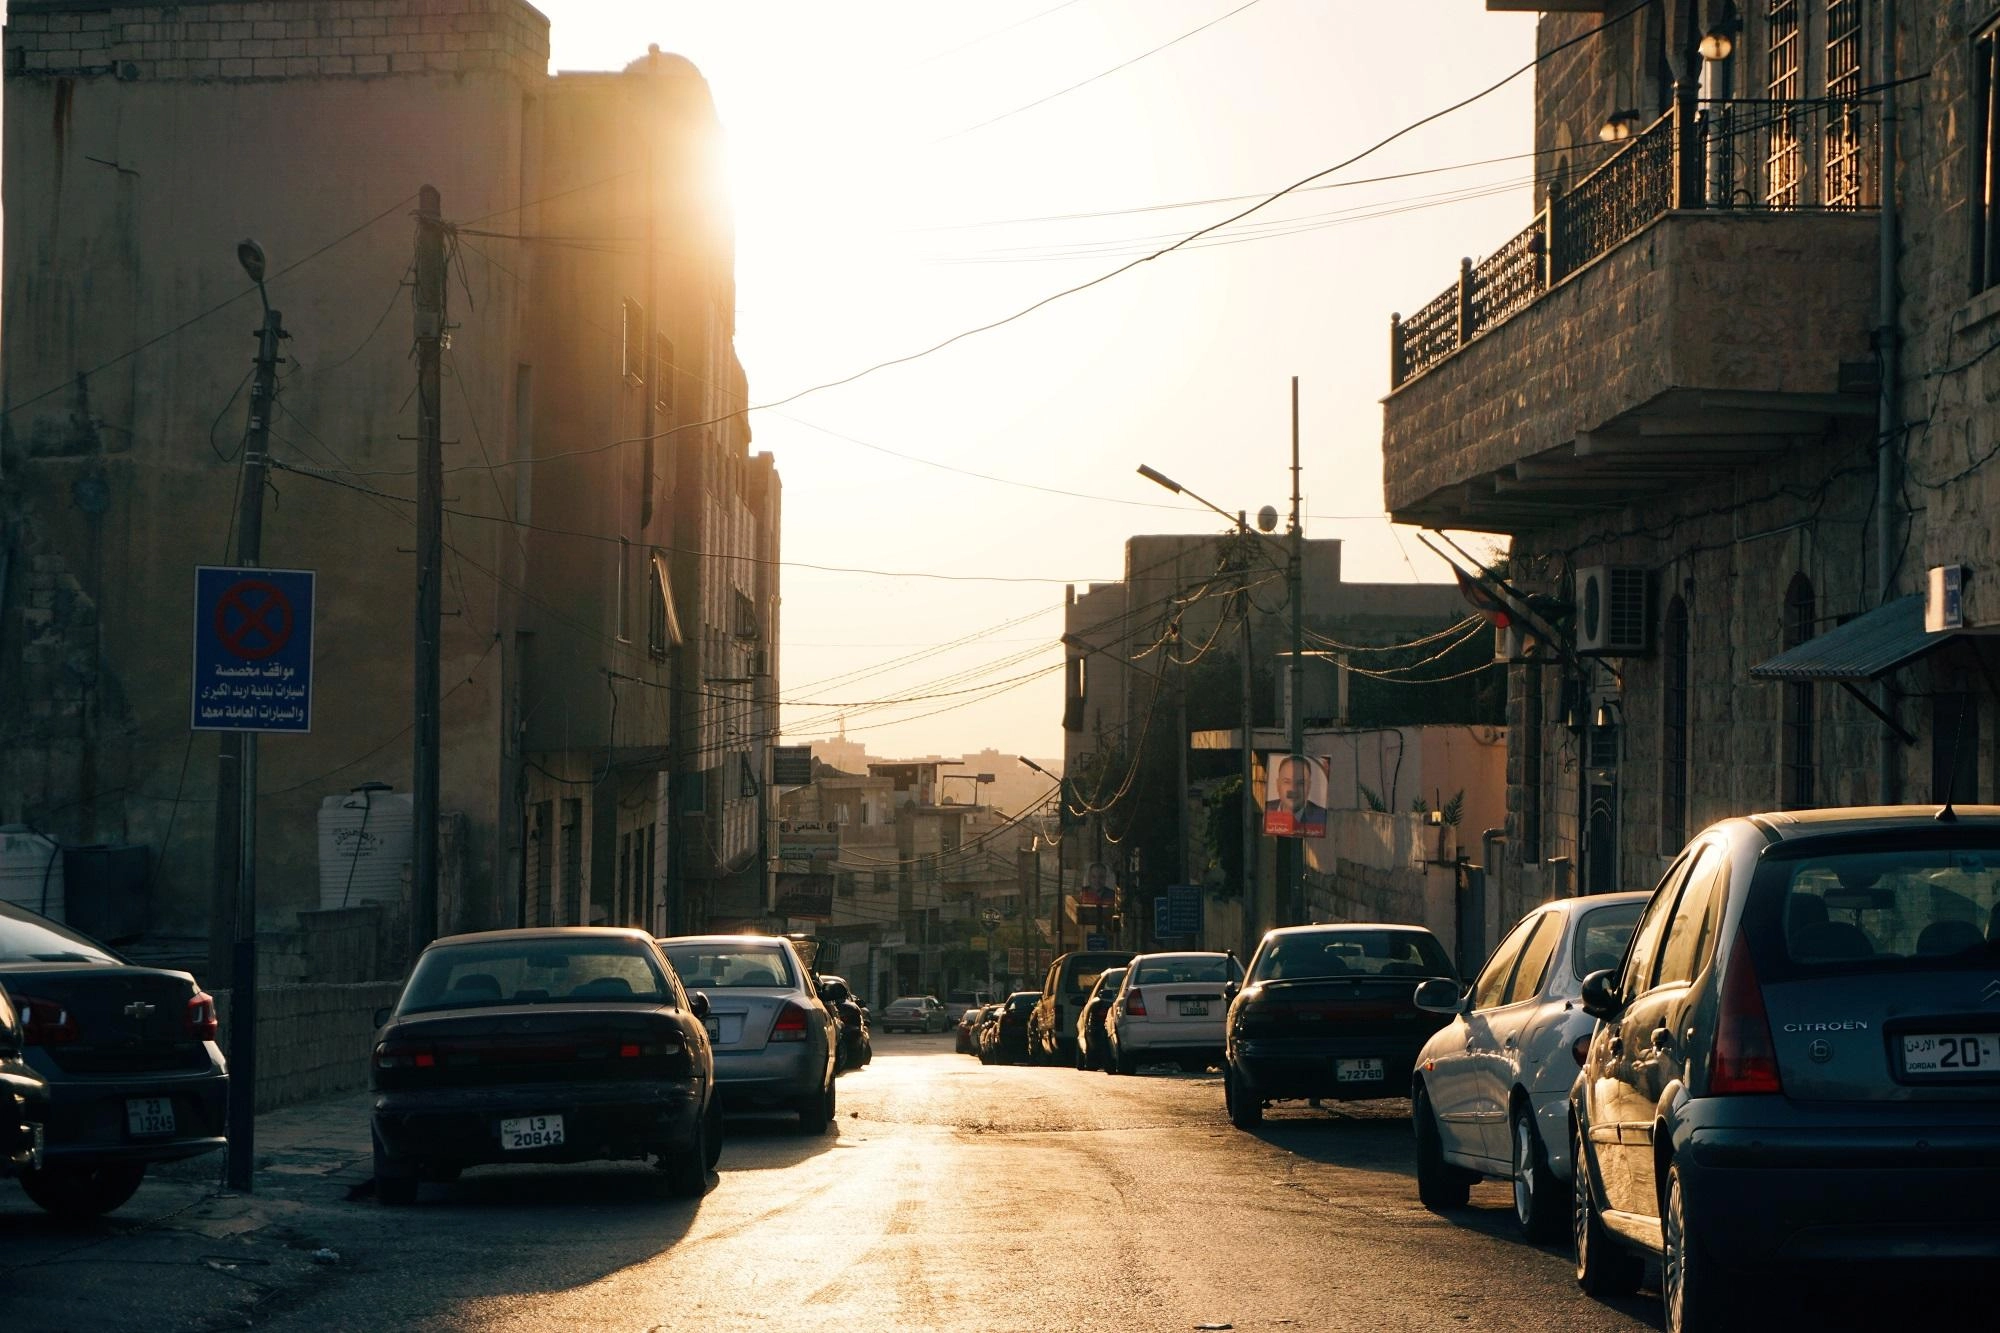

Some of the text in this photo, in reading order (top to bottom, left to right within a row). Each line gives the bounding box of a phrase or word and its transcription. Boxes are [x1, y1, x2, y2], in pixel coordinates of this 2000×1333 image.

[215, 661, 295, 681] مواقف مخصصة
[201, 683, 231, 700] الكبرى
[250, 684, 273, 700] بلدية
[275, 683, 305, 700] لسيارات
[201, 704, 304, 722] والسيارات العاملة معها
[1783, 1020, 1869, 1032] CITROËN
[1358, 1060, 1371, 1069] 16
[1908, 1062, 1937, 1070] JORDAN
[530, 1118, 546, 1131] 13
[514, 1130, 562, 1146] 20842
